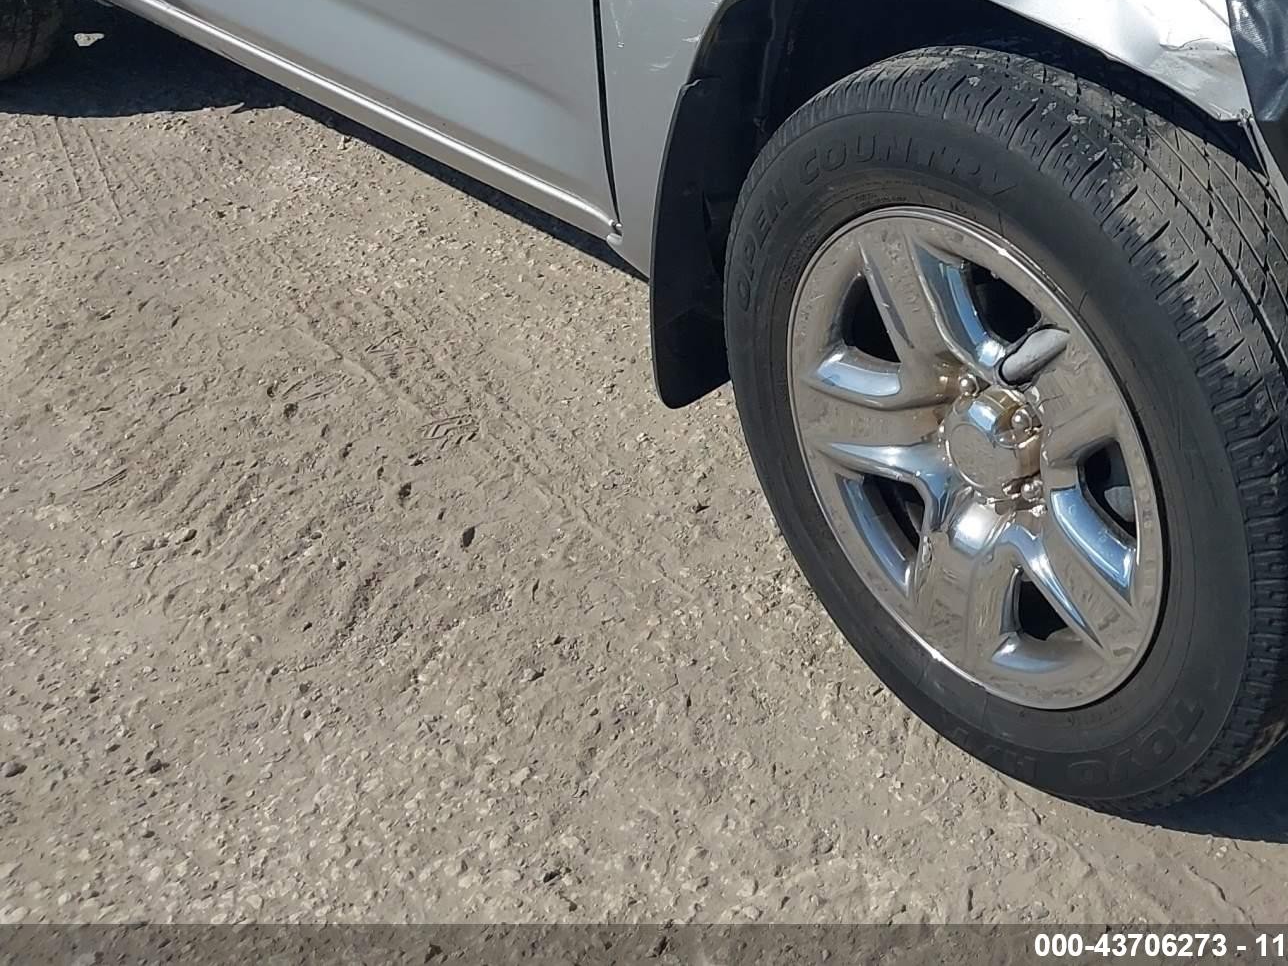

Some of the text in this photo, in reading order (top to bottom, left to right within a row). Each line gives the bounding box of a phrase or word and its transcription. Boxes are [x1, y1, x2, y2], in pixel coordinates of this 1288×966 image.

[736, 178, 790, 313] OPEN
[800, 134, 1017, 197] COUNTRY
[1066, 697, 1206, 786] TOYO
